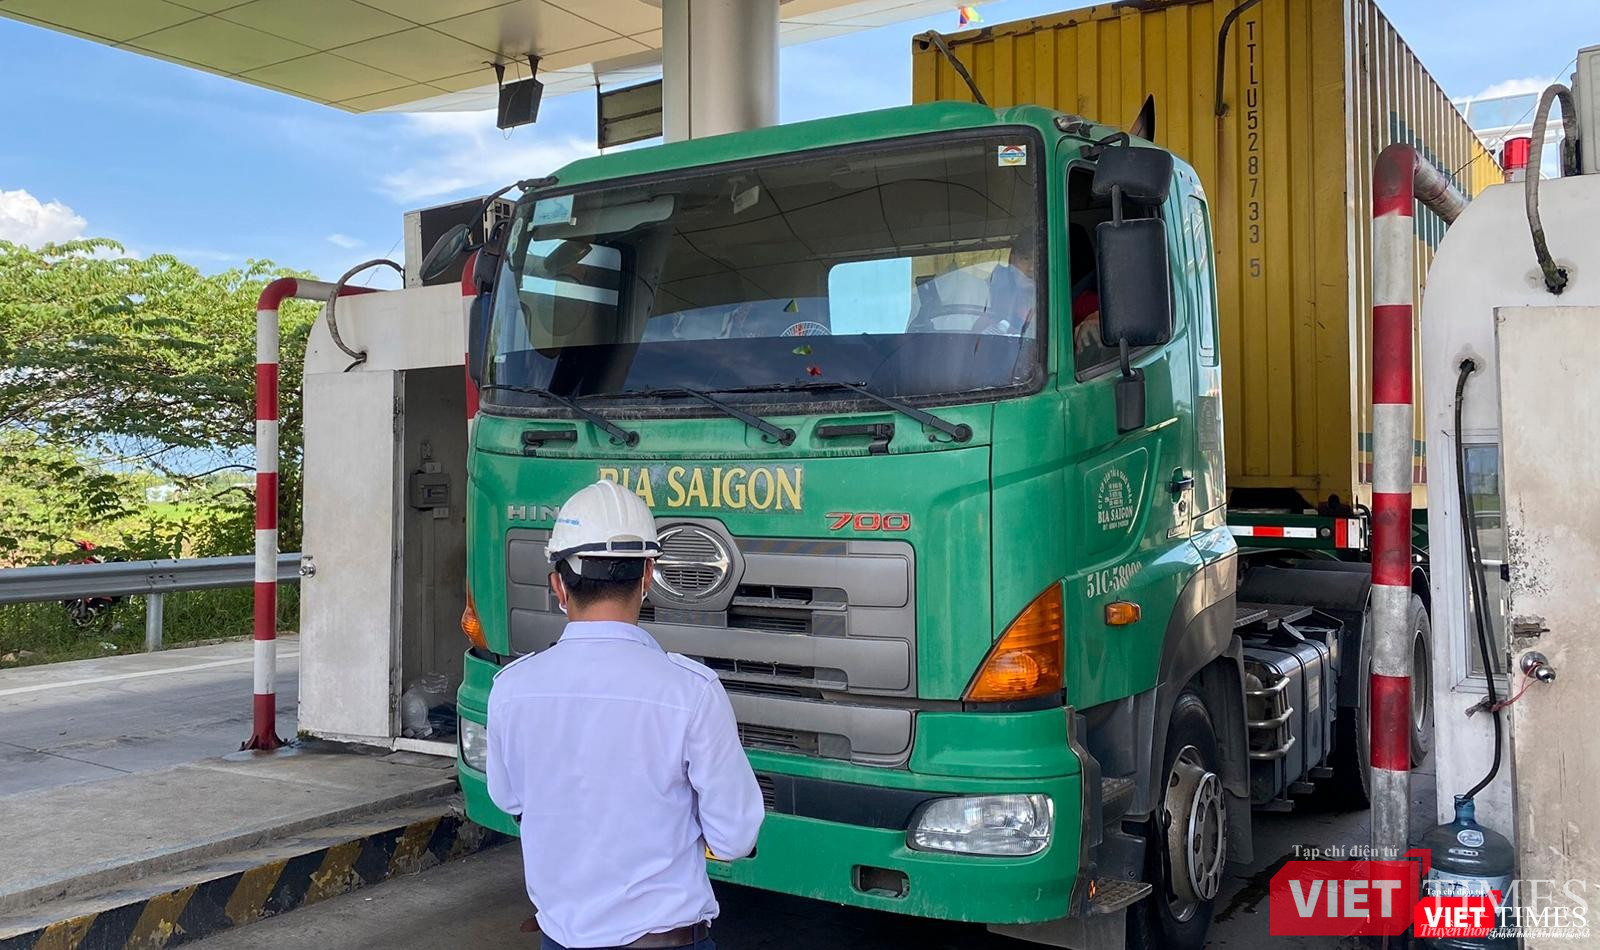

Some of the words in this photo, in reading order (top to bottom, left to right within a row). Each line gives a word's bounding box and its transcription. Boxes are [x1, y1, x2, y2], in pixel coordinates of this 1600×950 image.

[667, 466, 803, 511] SAIGON
[507, 504, 561, 521] HIN
[825, 511, 911, 532] 700
[1097, 510, 1110, 524] BIA
[1110, 505, 1134, 521] SAIGON
